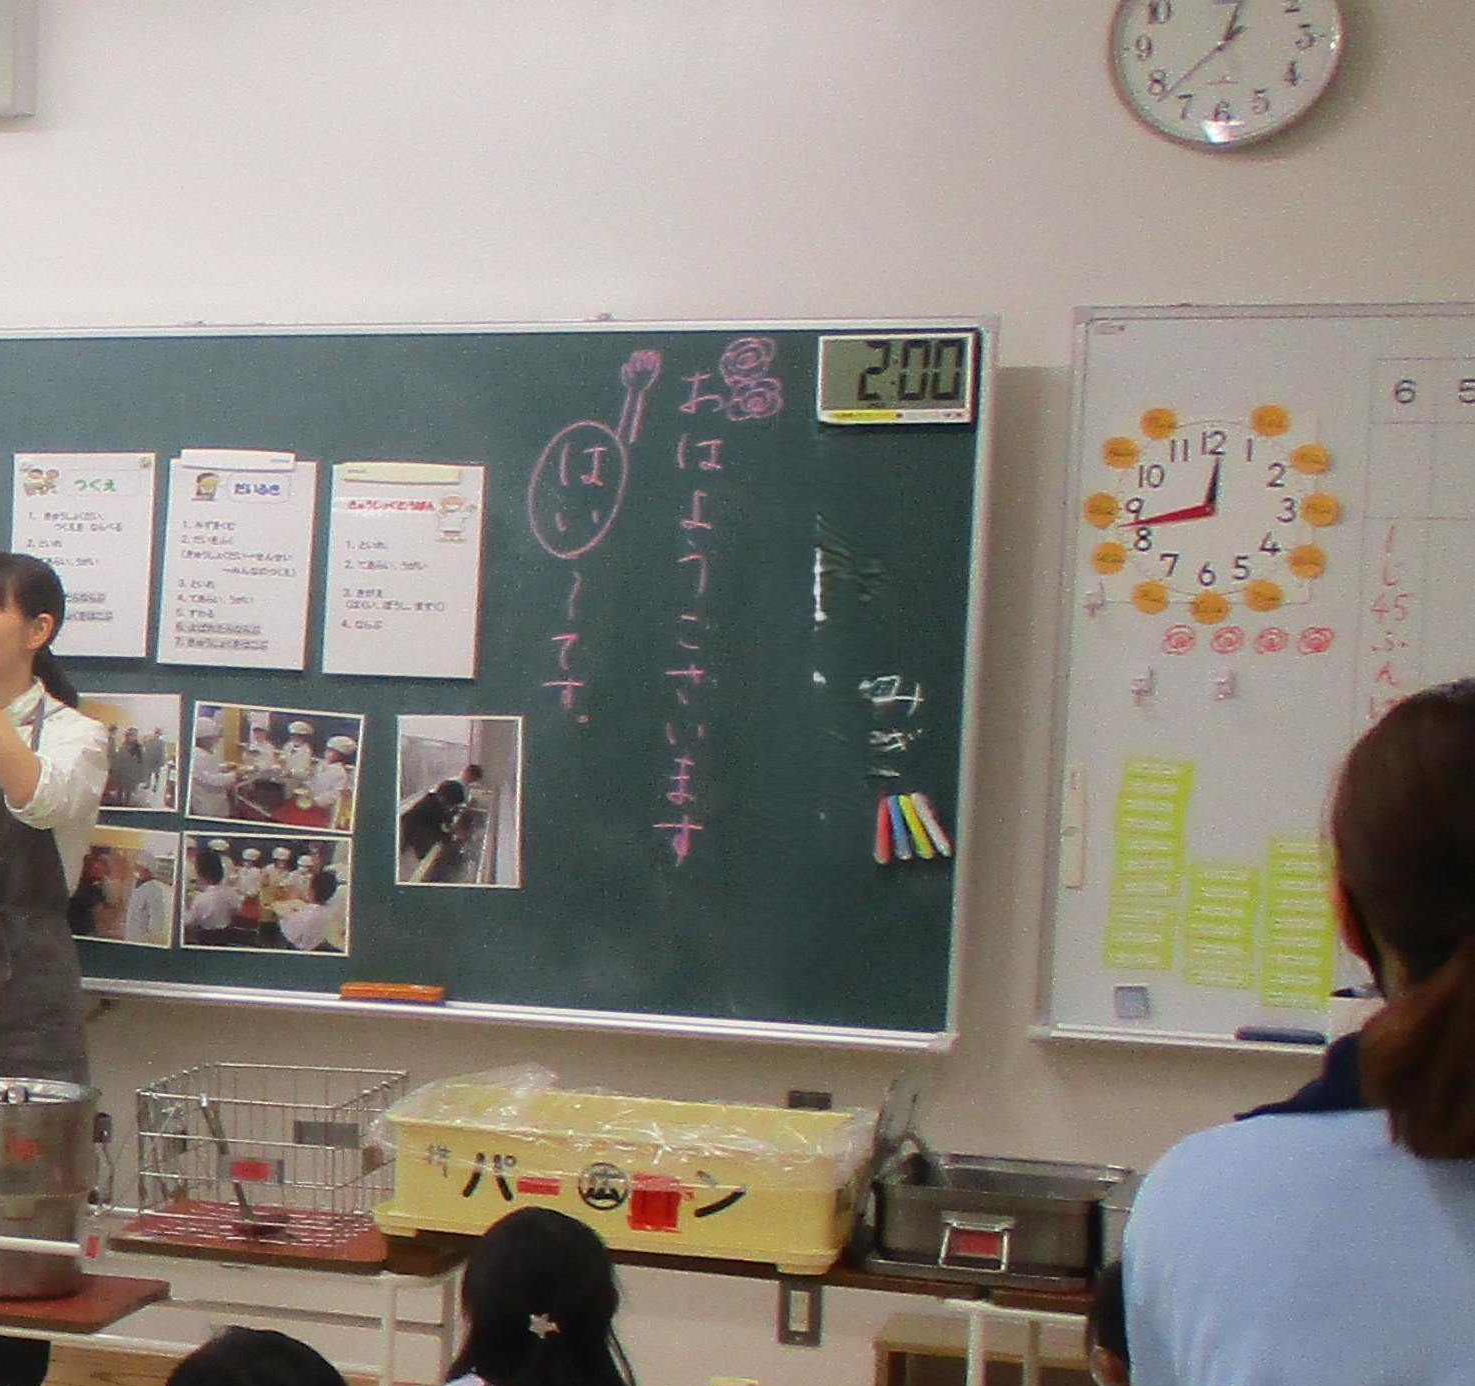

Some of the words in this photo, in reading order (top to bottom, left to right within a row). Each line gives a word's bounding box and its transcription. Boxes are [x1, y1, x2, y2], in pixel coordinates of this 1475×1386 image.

[1395, 379, 1417, 404] 6
[1170, 439, 1189, 463] 11
[1200, 430, 1226, 456] 12
[74, 479, 117, 492] つくえ
[1137, 464, 1165, 489] 10
[1266, 462, 1286, 488] 2
[1125, 497, 1145, 521] 9
[1276, 497, 1297, 523] 3
[1133, 526, 1152, 552] 8
[1259, 531, 1280, 557] 4
[1159, 553, 1179, 577] 7
[1198, 561, 1216, 586] 6
[1232, 556, 1250, 580] 5
